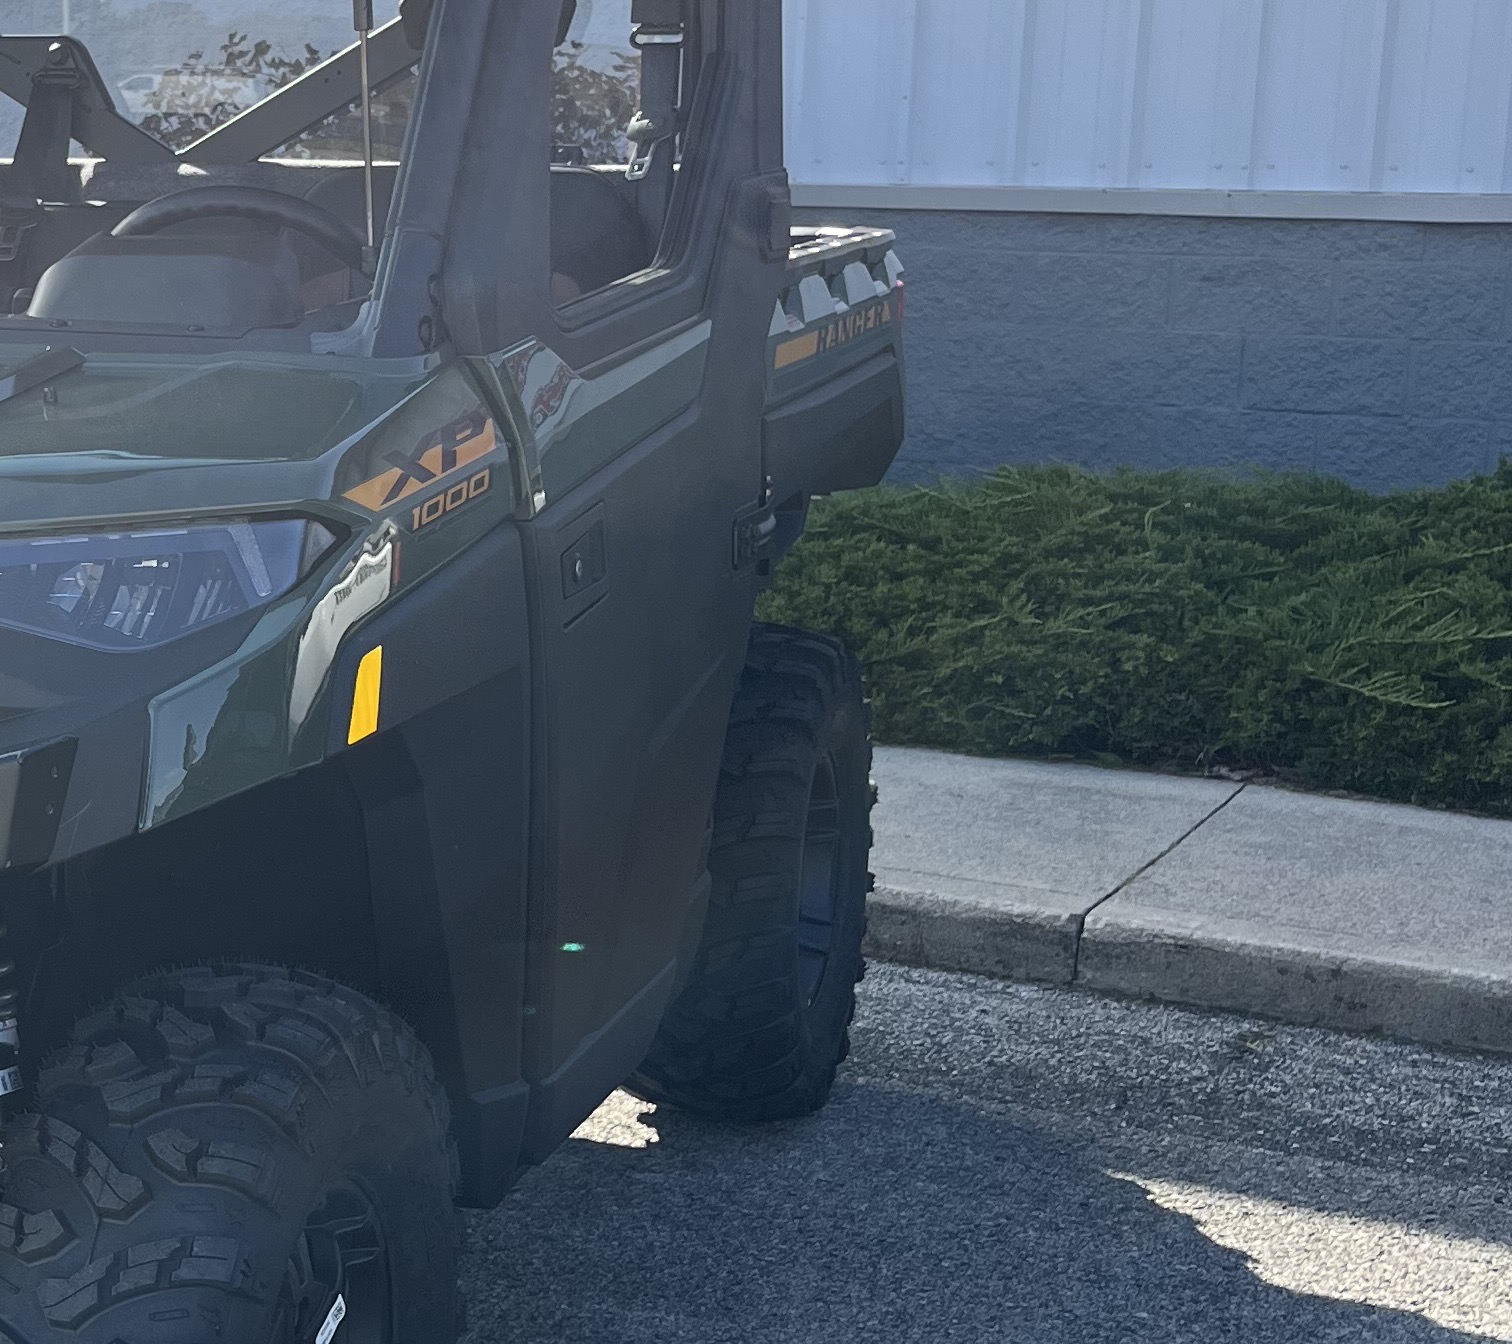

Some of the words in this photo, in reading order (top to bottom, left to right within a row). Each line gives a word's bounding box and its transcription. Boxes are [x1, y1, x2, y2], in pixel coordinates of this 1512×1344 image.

[816, 302, 887, 354] RANGER
[377, 408, 487, 507] XP
[411, 468, 489, 531] 1000
